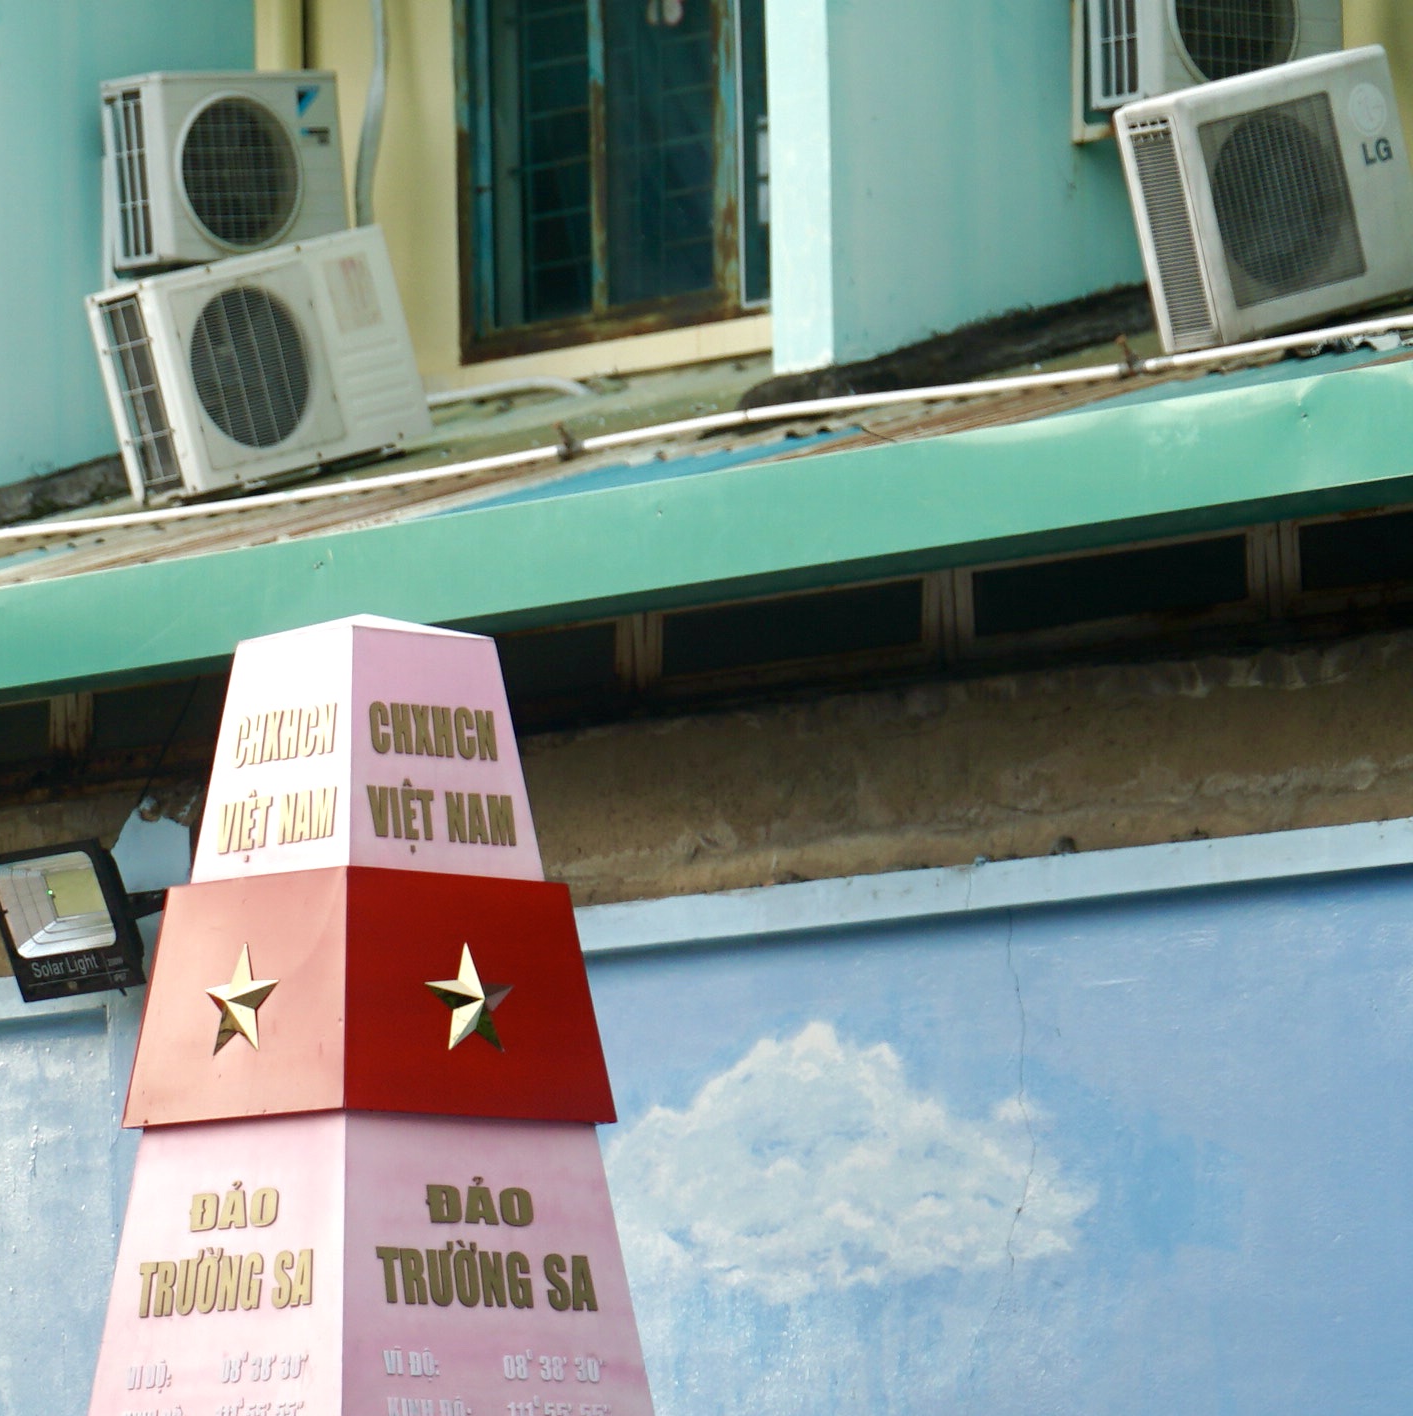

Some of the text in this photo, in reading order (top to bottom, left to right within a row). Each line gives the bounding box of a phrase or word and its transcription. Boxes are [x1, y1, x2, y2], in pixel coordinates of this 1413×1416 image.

[1361, 137, 1394, 166] LG
[233, 702, 338, 768] CHXHCN
[369, 701, 498, 762] CHXHCN
[217, 786, 338, 862] VIỆT NAM
[366, 778, 517, 854] VIỆT NAM
[31, 957, 66, 979] Solar
[66, 953, 99, 975] Light
[189, 1180, 280, 1233] ĐẢO
[426, 1176, 534, 1227] ĐẢO
[139, 1246, 315, 1318] TRƯỜNG SA
[375, 1241, 599, 1312] TRƯỜNG SA
